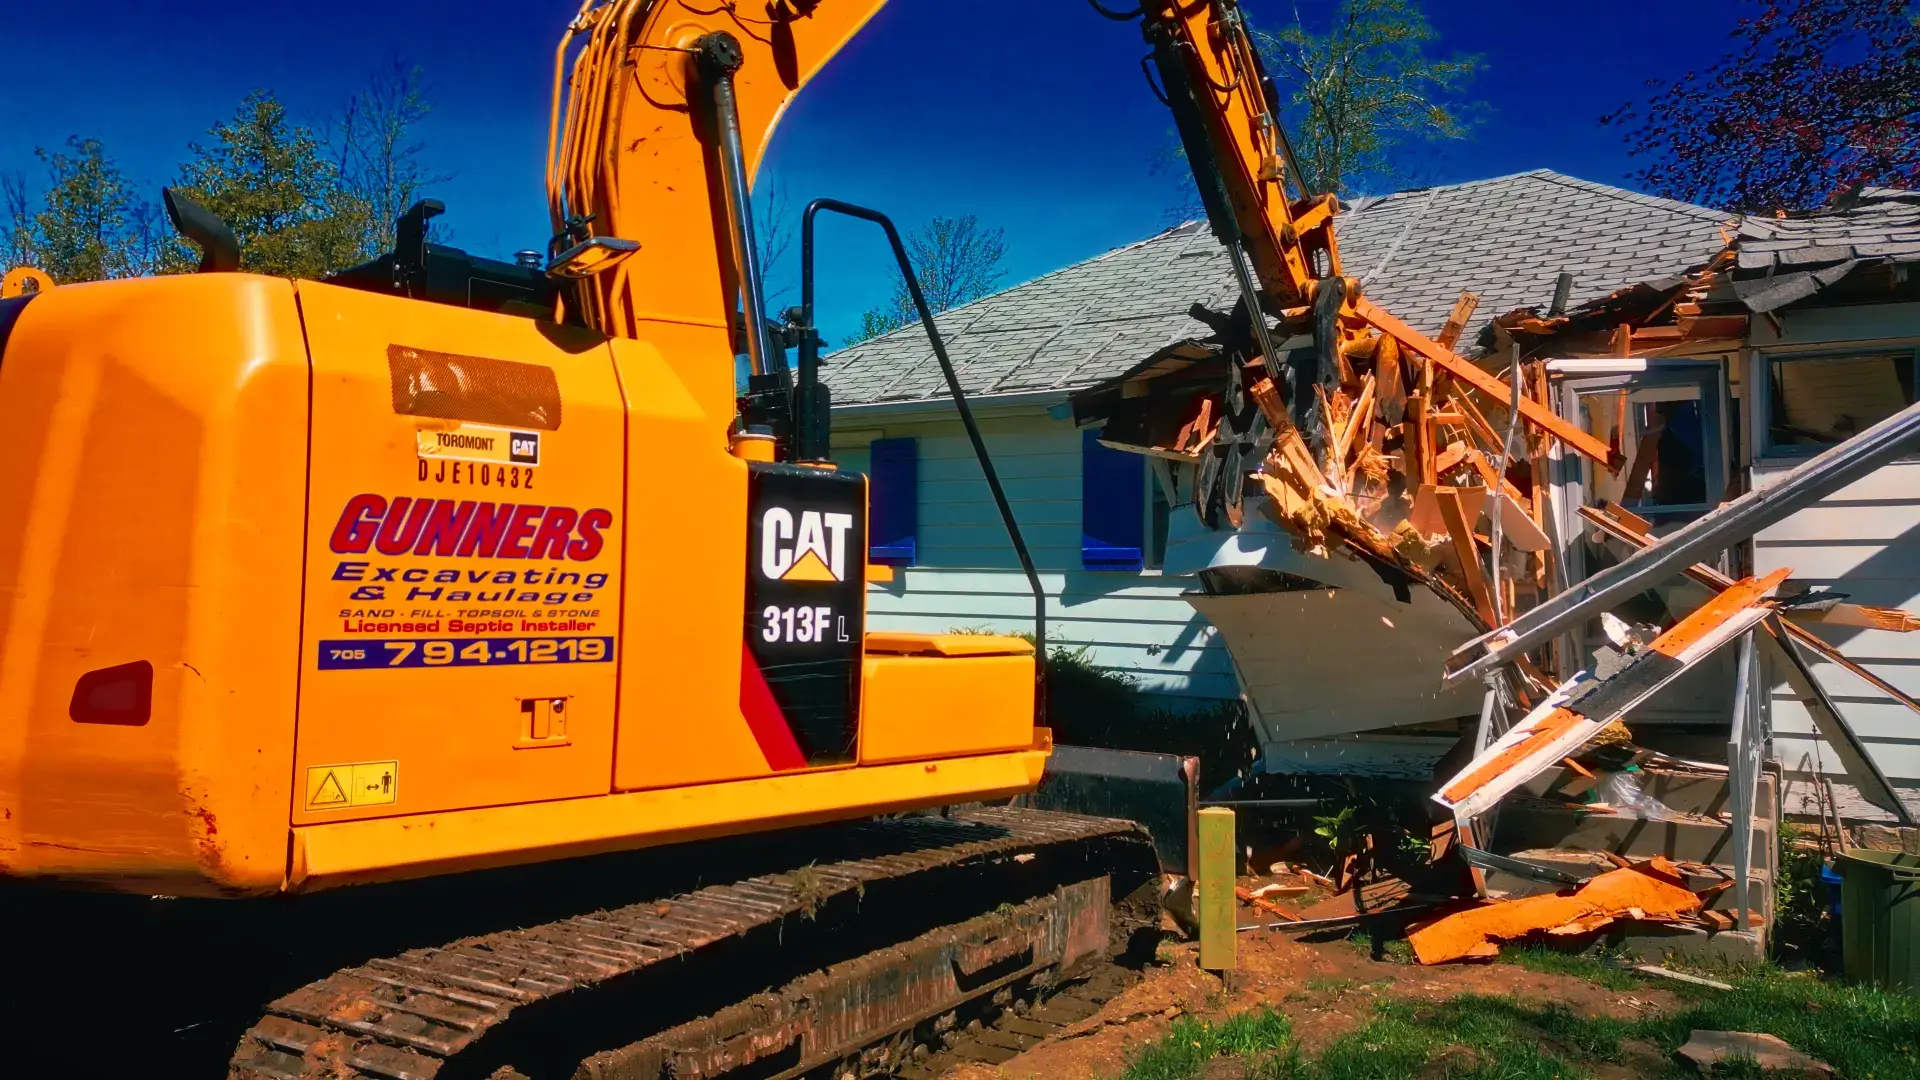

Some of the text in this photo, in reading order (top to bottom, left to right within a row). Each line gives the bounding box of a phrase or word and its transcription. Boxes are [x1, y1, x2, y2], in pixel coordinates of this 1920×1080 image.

[436, 432, 495, 451] TOROMONT
[512, 439, 536, 456] CAT
[418, 459, 533, 489] DJE10432
[329, 493, 613, 562] GUNNERS
[761, 506, 852, 582] CAT
[331, 561, 609, 590] Excavating
[349, 586, 594, 605] & Haulage
[338, 608, 396, 618] SAND
[457, 608, 529, 618] TOPSOIL
[532, 608, 542, 618] &
[548, 608, 600, 618] STONE
[343, 619, 596, 635] Licensed Septic Installer
[762, 605, 849, 643] 313F L
[330, 638, 606, 666] 705 794-1219
